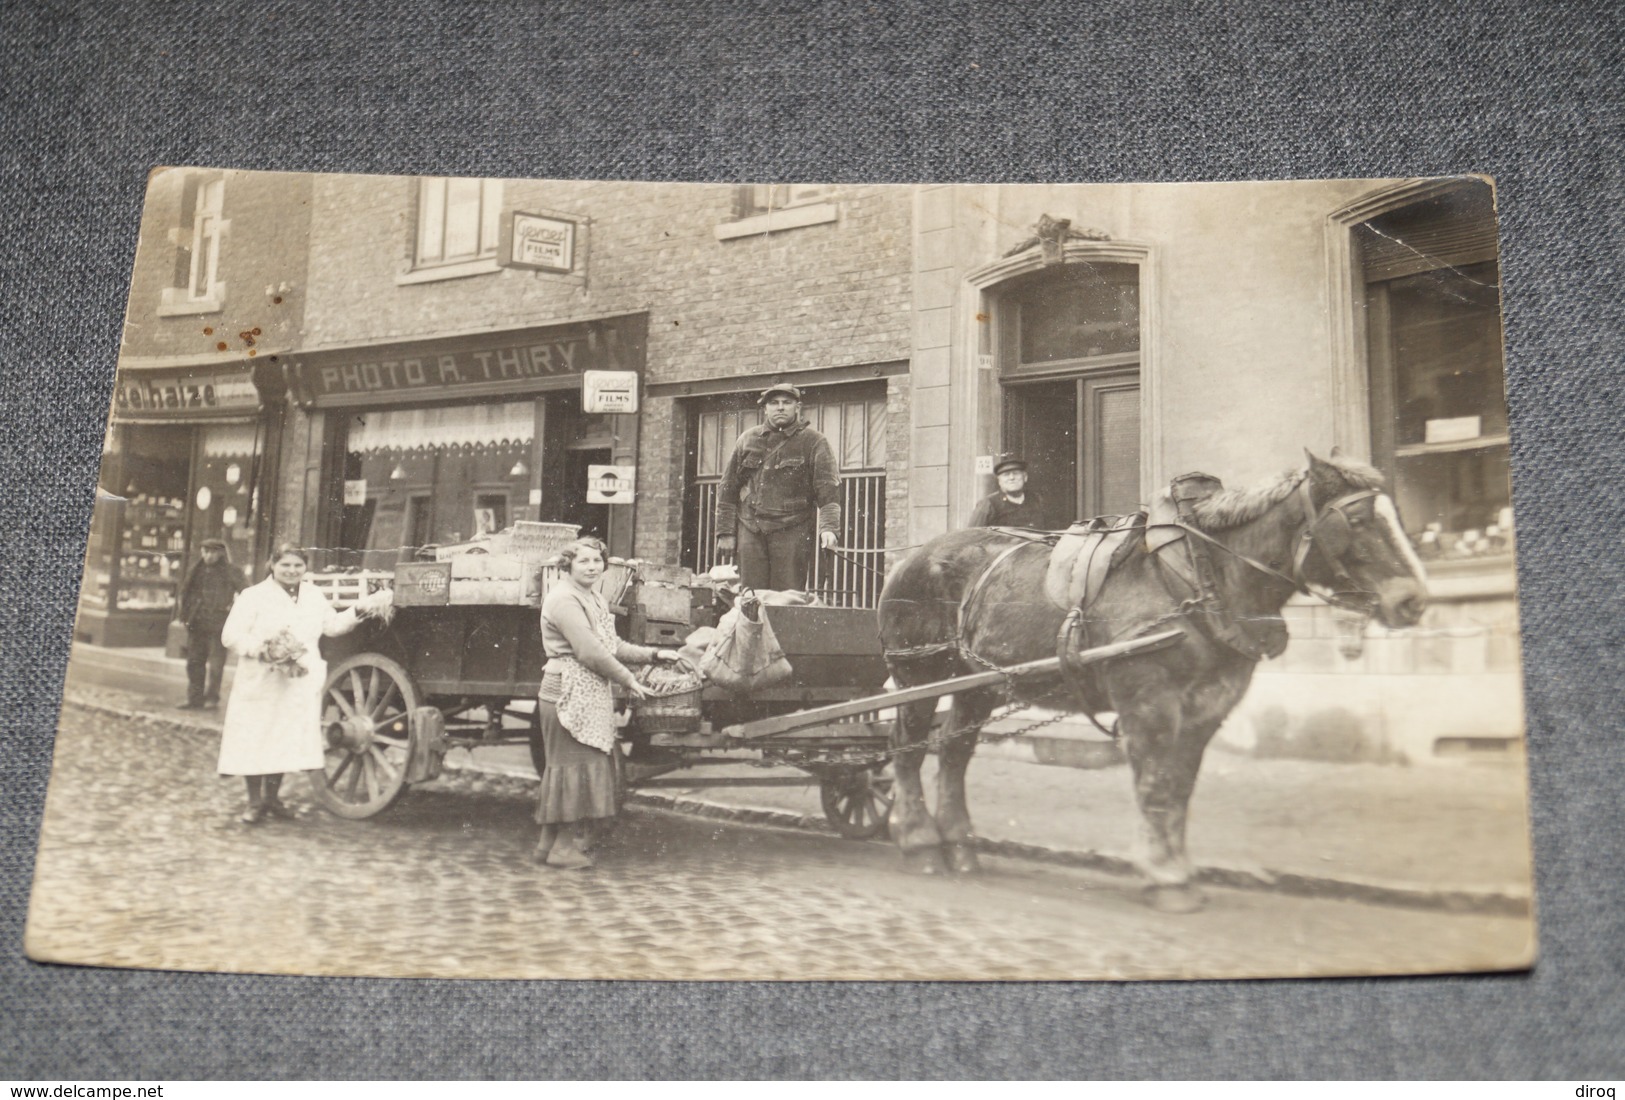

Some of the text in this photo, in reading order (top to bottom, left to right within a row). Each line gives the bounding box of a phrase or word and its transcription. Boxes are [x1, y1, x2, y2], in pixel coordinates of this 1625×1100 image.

[526, 244, 561, 257] FILMS
[321, 341, 577, 391] PHOTO A. THIRY
[598, 394, 630, 403] FILMS
